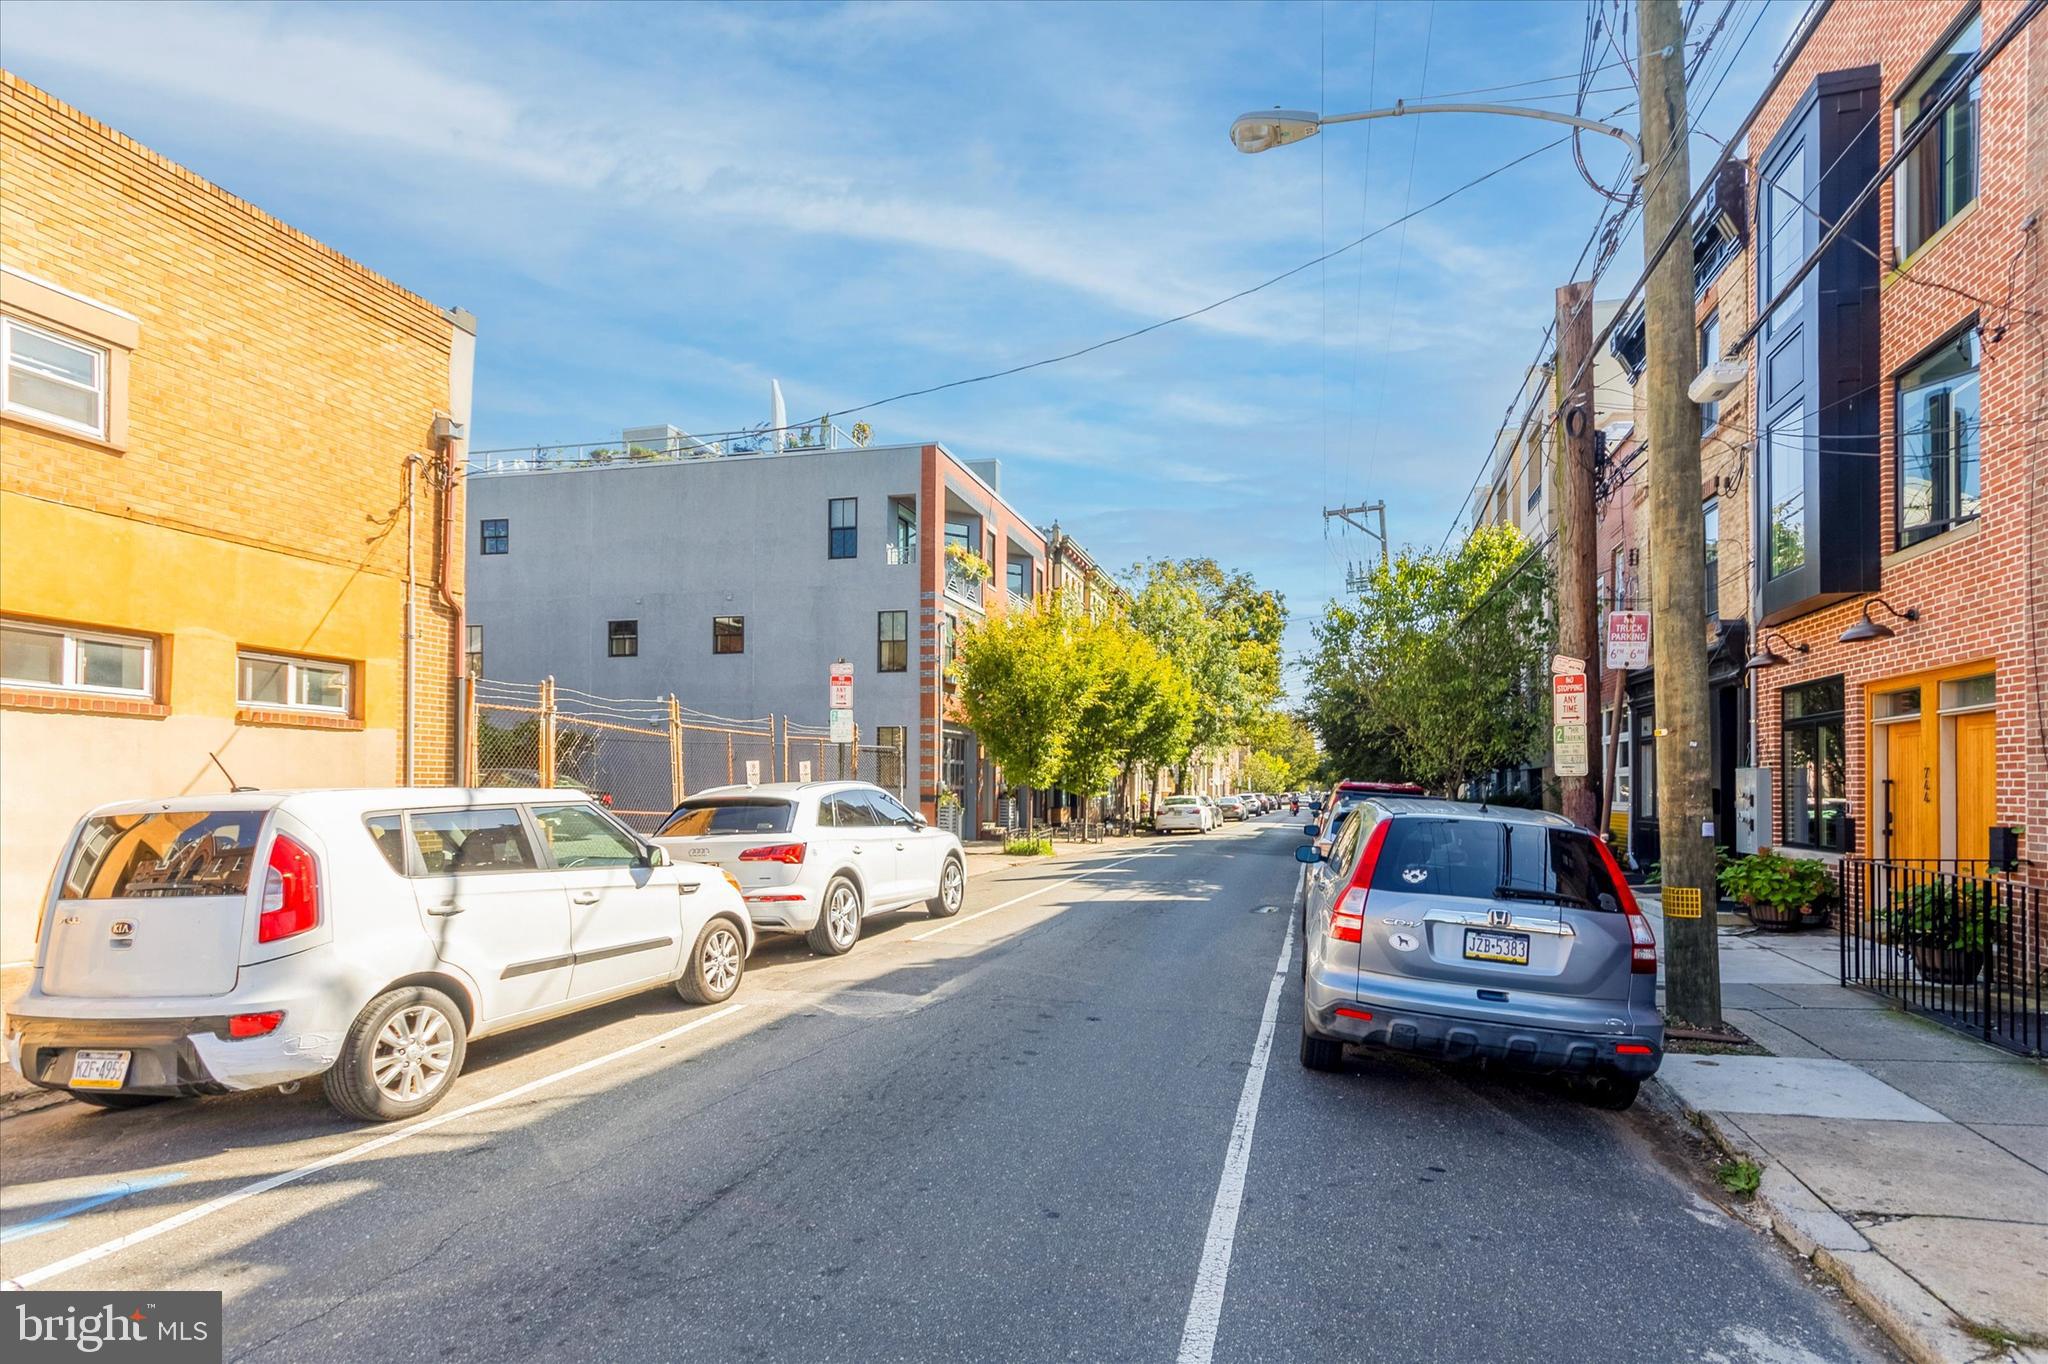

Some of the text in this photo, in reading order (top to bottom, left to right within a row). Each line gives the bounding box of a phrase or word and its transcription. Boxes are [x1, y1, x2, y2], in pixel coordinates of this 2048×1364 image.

[1623, 615, 1636, 624] NO
[1615, 623, 1643, 632] TRUCK
[1611, 632, 1646, 641] PARKING
[1565, 676, 1575, 684] NO
[1556, 684, 1584, 693] STOPPING
[1563, 695, 1577, 704] ANY
[1563, 704, 1579, 713] TIME
[1556, 728, 1564, 742] 2
[1923, 767, 1931, 804] 744
[112, 922, 130, 934] KIA
